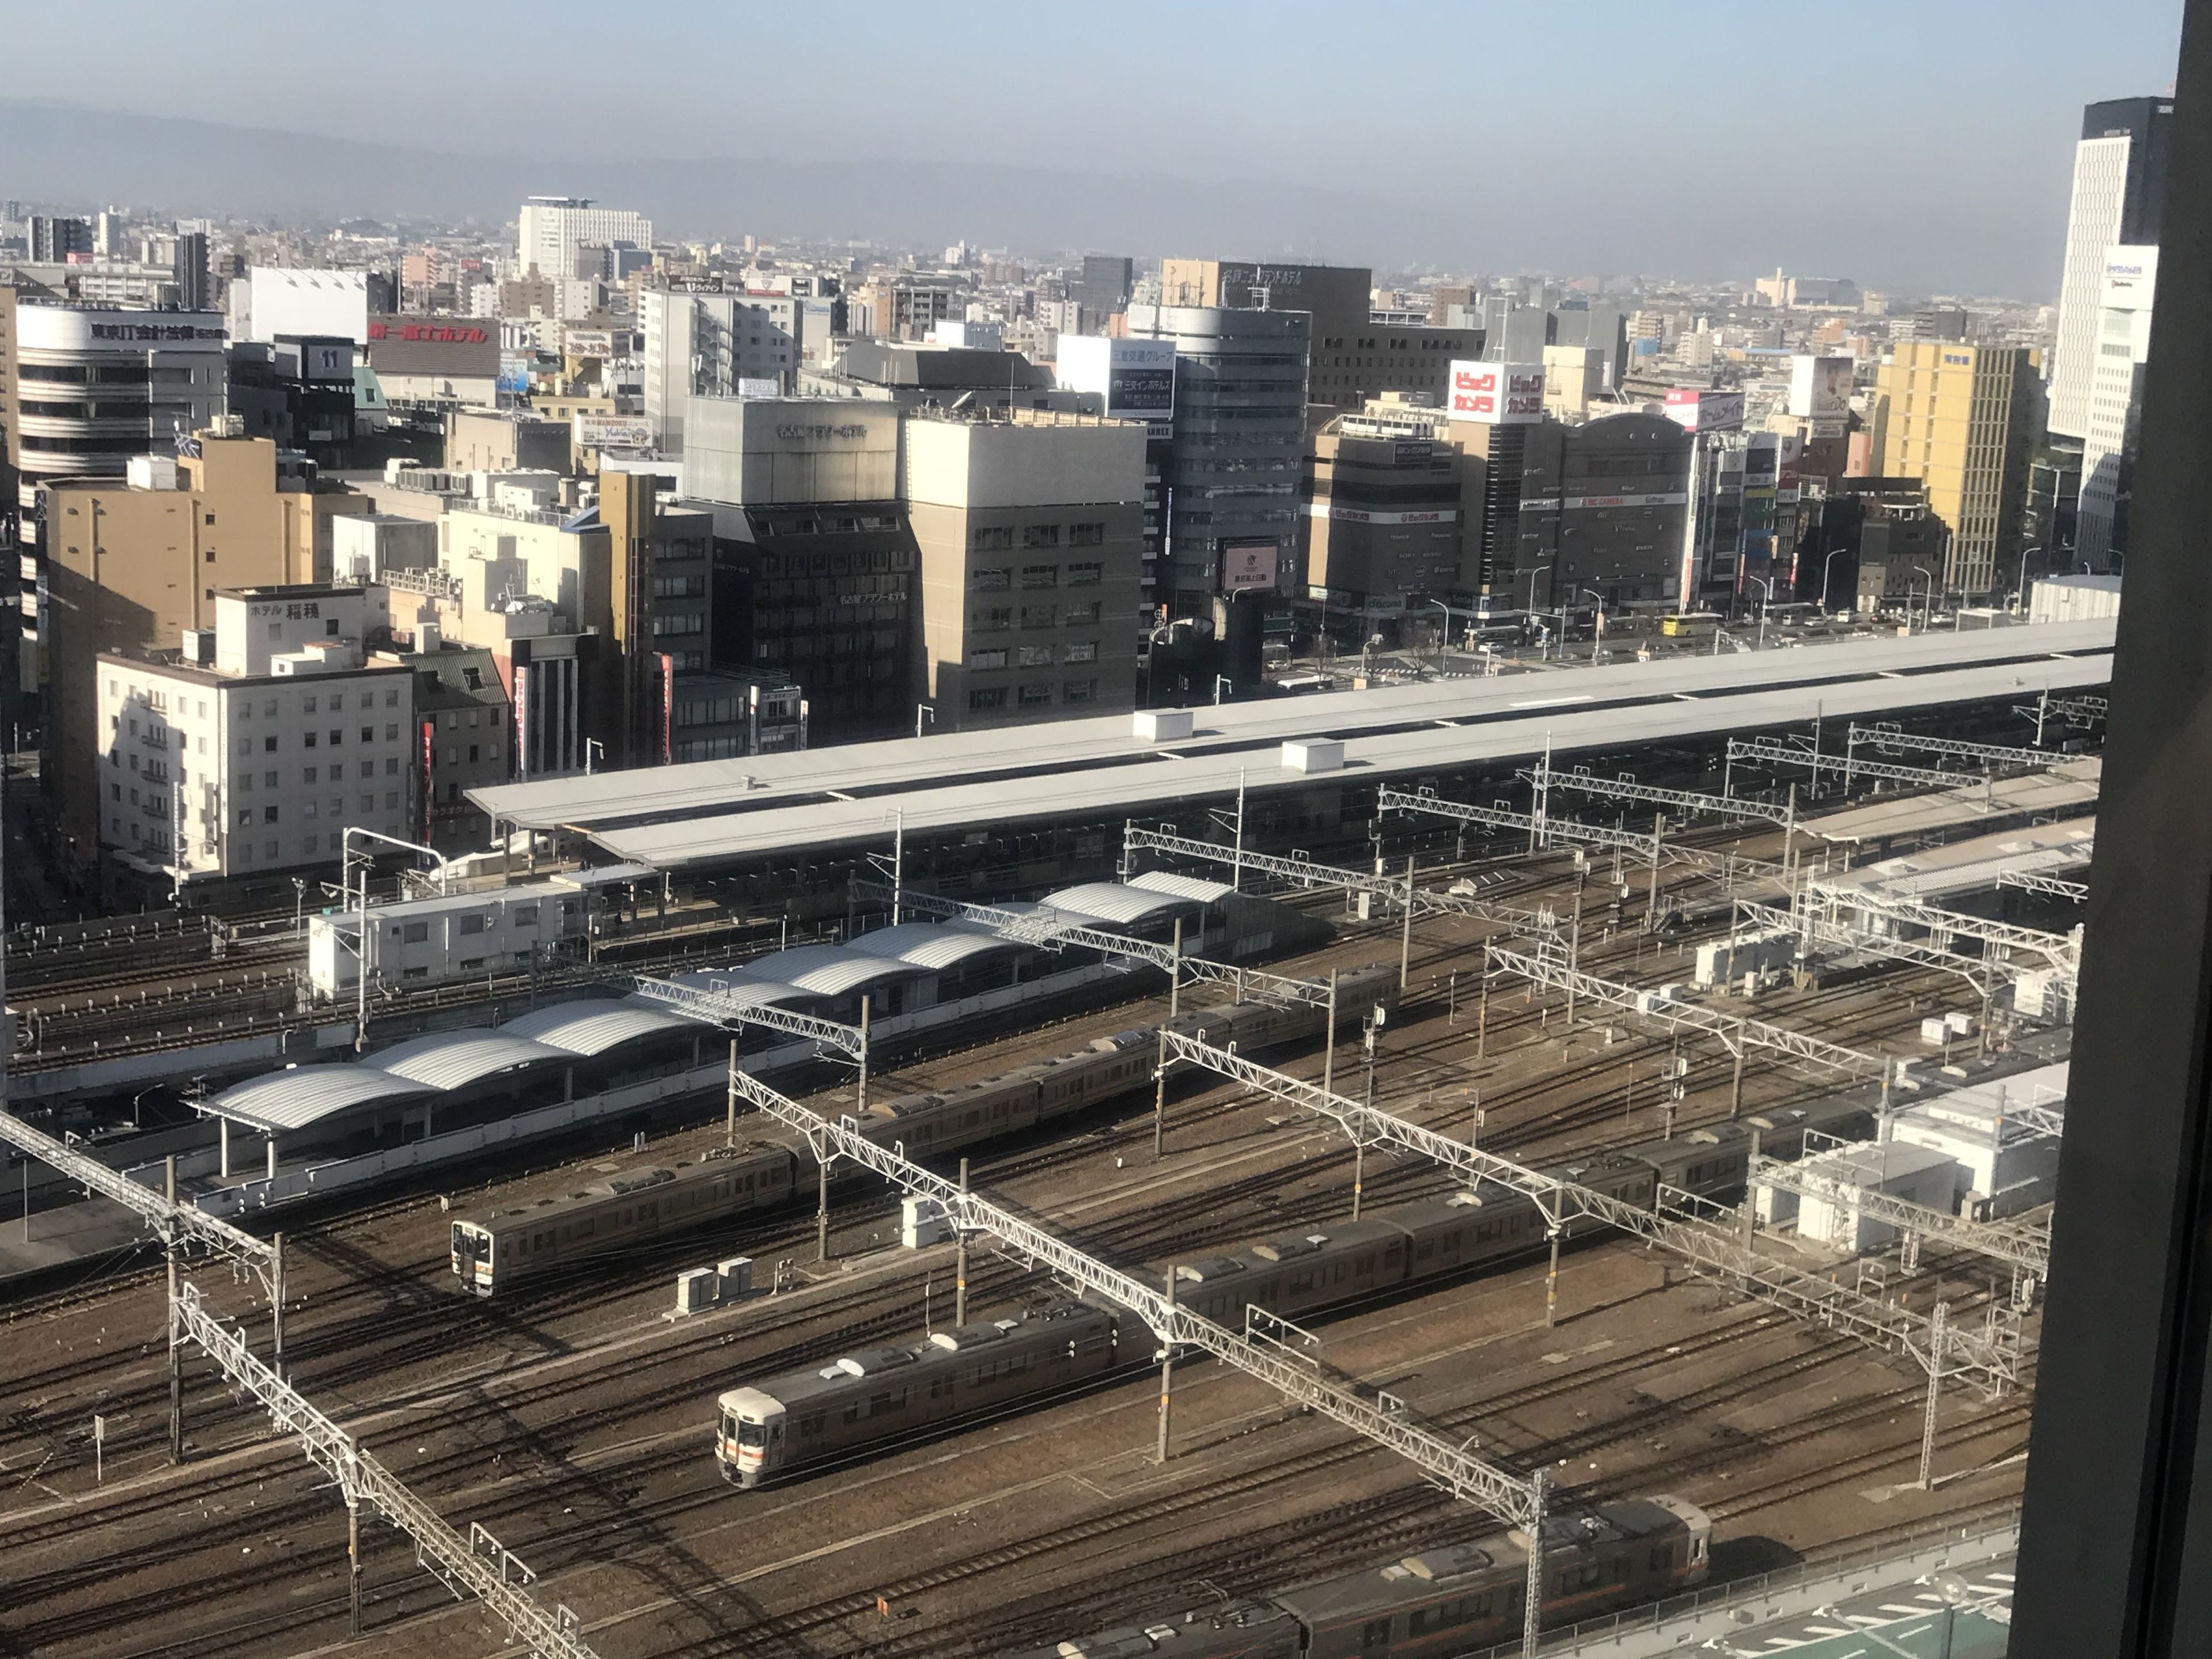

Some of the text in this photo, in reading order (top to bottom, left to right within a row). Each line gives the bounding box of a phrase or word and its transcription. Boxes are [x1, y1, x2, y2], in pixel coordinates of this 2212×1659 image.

[321, 350, 339, 368] 11
[1113, 350, 1173, 362] 三重交通グループ
[1125, 380, 1171, 391] 三交インホテルズ
[1456, 372, 1496, 392] ビック
[1509, 374, 1543, 392] ビック
[1454, 394, 1494, 414] カメラ
[1506, 397, 1541, 414] カメラ
[1699, 400, 1744, 425] ホームメイト
[1147, 427, 1170, 436] ANNEX
[1599, 497, 1624, 506] CAMERA
[1335, 509, 1370, 521] ビックカメラ
[1408, 513, 1439, 522] ビックカメラ
[840, 592, 907, 604] 名古屋フラワーホテル
[1369, 600, 1403, 608] docomo
[251, 602, 319, 620] ホテル 稲穂
